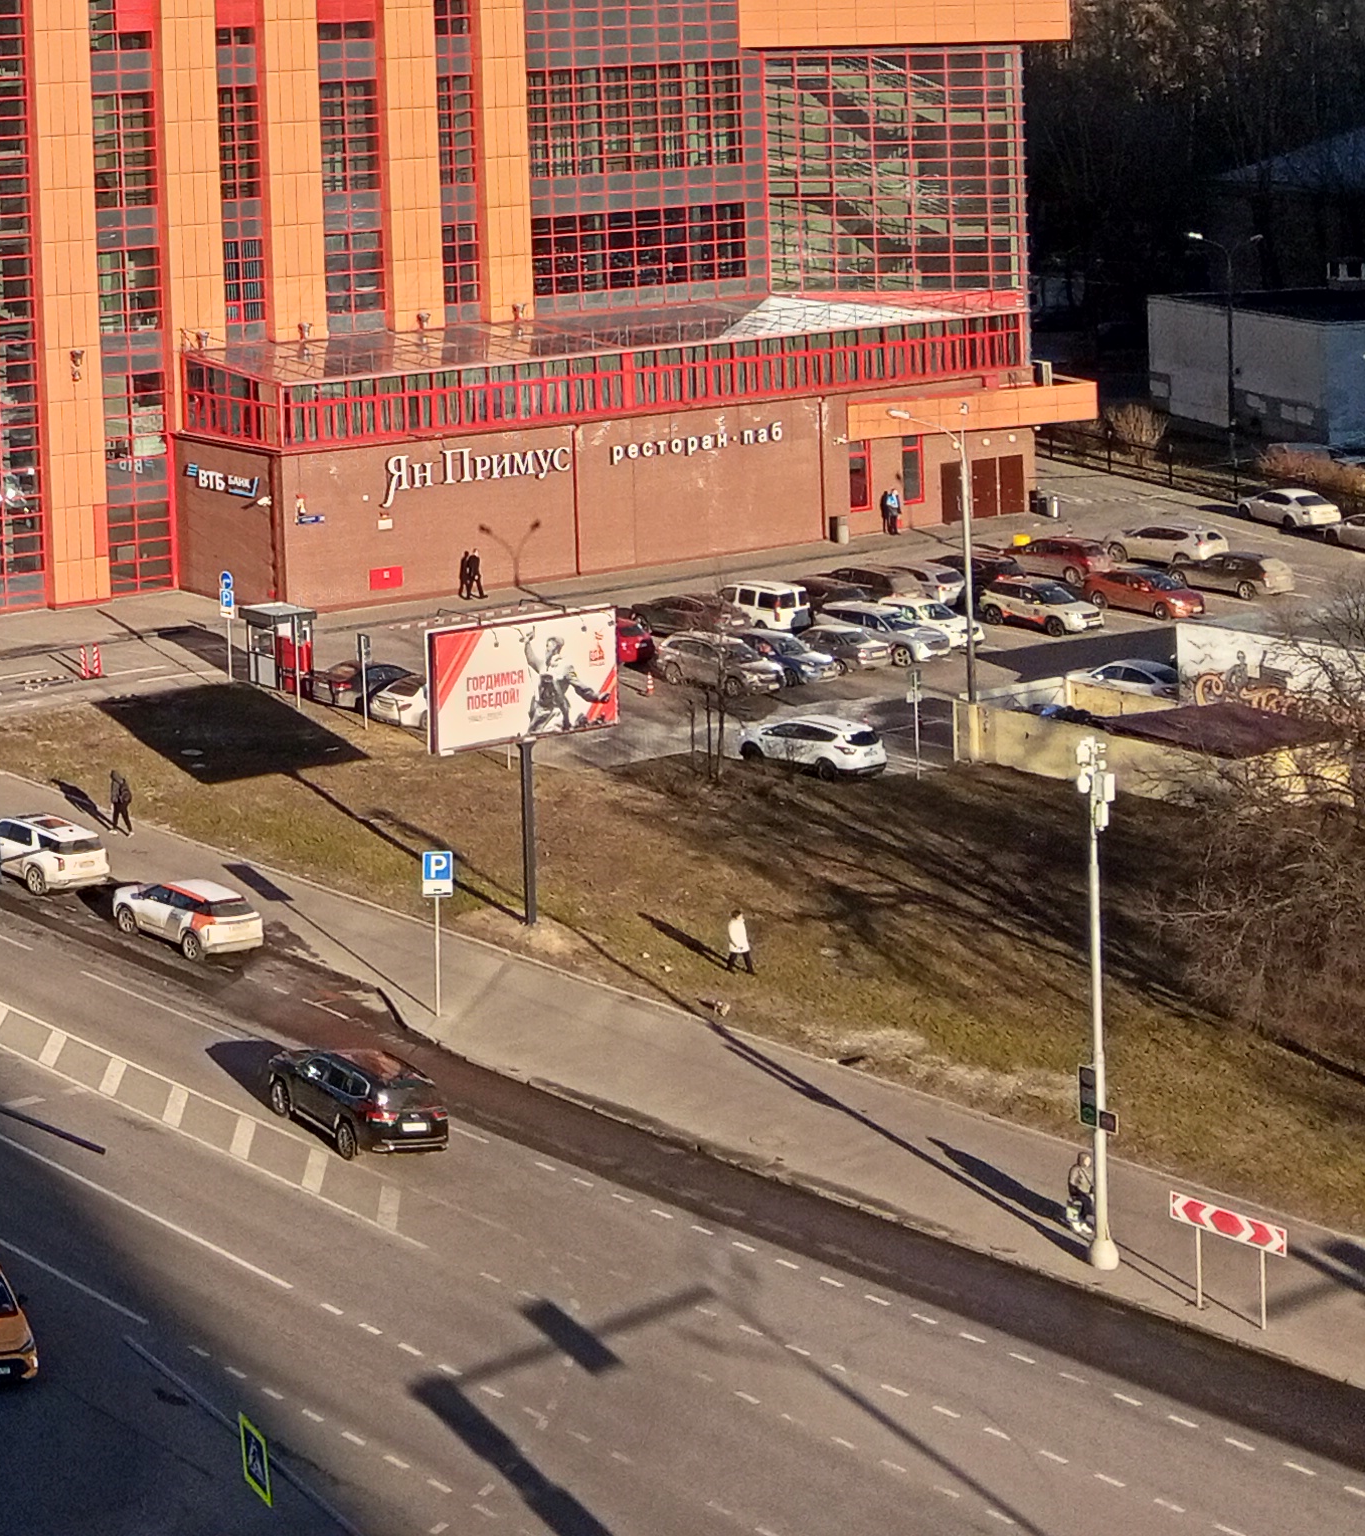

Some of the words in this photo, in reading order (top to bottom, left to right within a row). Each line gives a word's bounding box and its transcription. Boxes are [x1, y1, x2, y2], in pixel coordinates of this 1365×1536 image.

[612, 433, 728, 465] ресторан
[743, 421, 783, 445] паб
[198, 469, 226, 492] ВТБ
[228, 475, 251, 489] БАНК
[382, 455, 434, 508] Ян
[442, 446, 571, 485] Примус
[466, 669, 525, 692] ГОРДИМСЯ
[467, 687, 520, 711] ПОБЕДОЙ!
[430, 854, 448, 879] P
